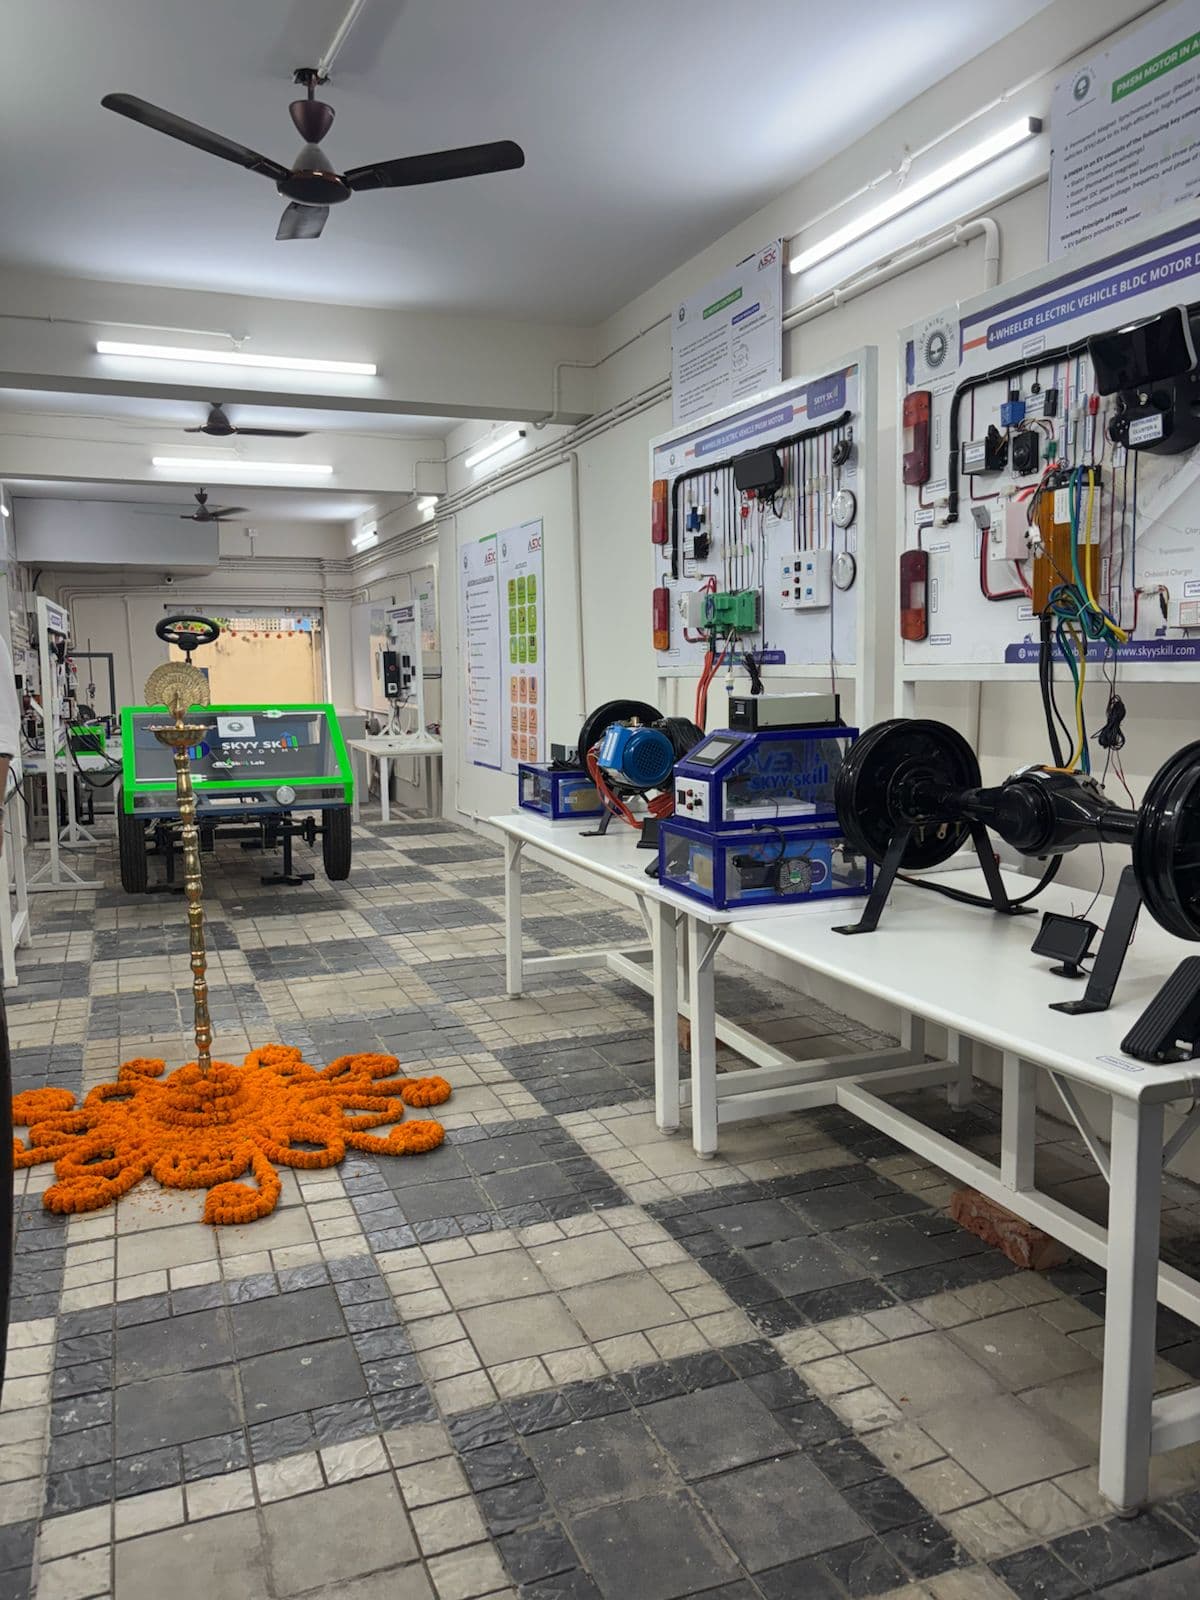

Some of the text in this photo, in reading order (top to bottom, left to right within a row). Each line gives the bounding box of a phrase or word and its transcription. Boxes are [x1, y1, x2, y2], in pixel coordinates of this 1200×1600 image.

[1116, 72, 1142, 94] PMSM
[1144, 52, 1178, 78] MOTOR
[1180, 44, 1190, 58] IN
[989, 317, 1033, 342] 4-WHEELER
[1036, 300, 1076, 325] ELECTRIC
[1078, 284, 1118, 308] VEHICLE
[1120, 273, 1148, 293] BLDC
[1150, 256, 1192, 282] MOTOR
[222, 741, 258, 750] SKYY
